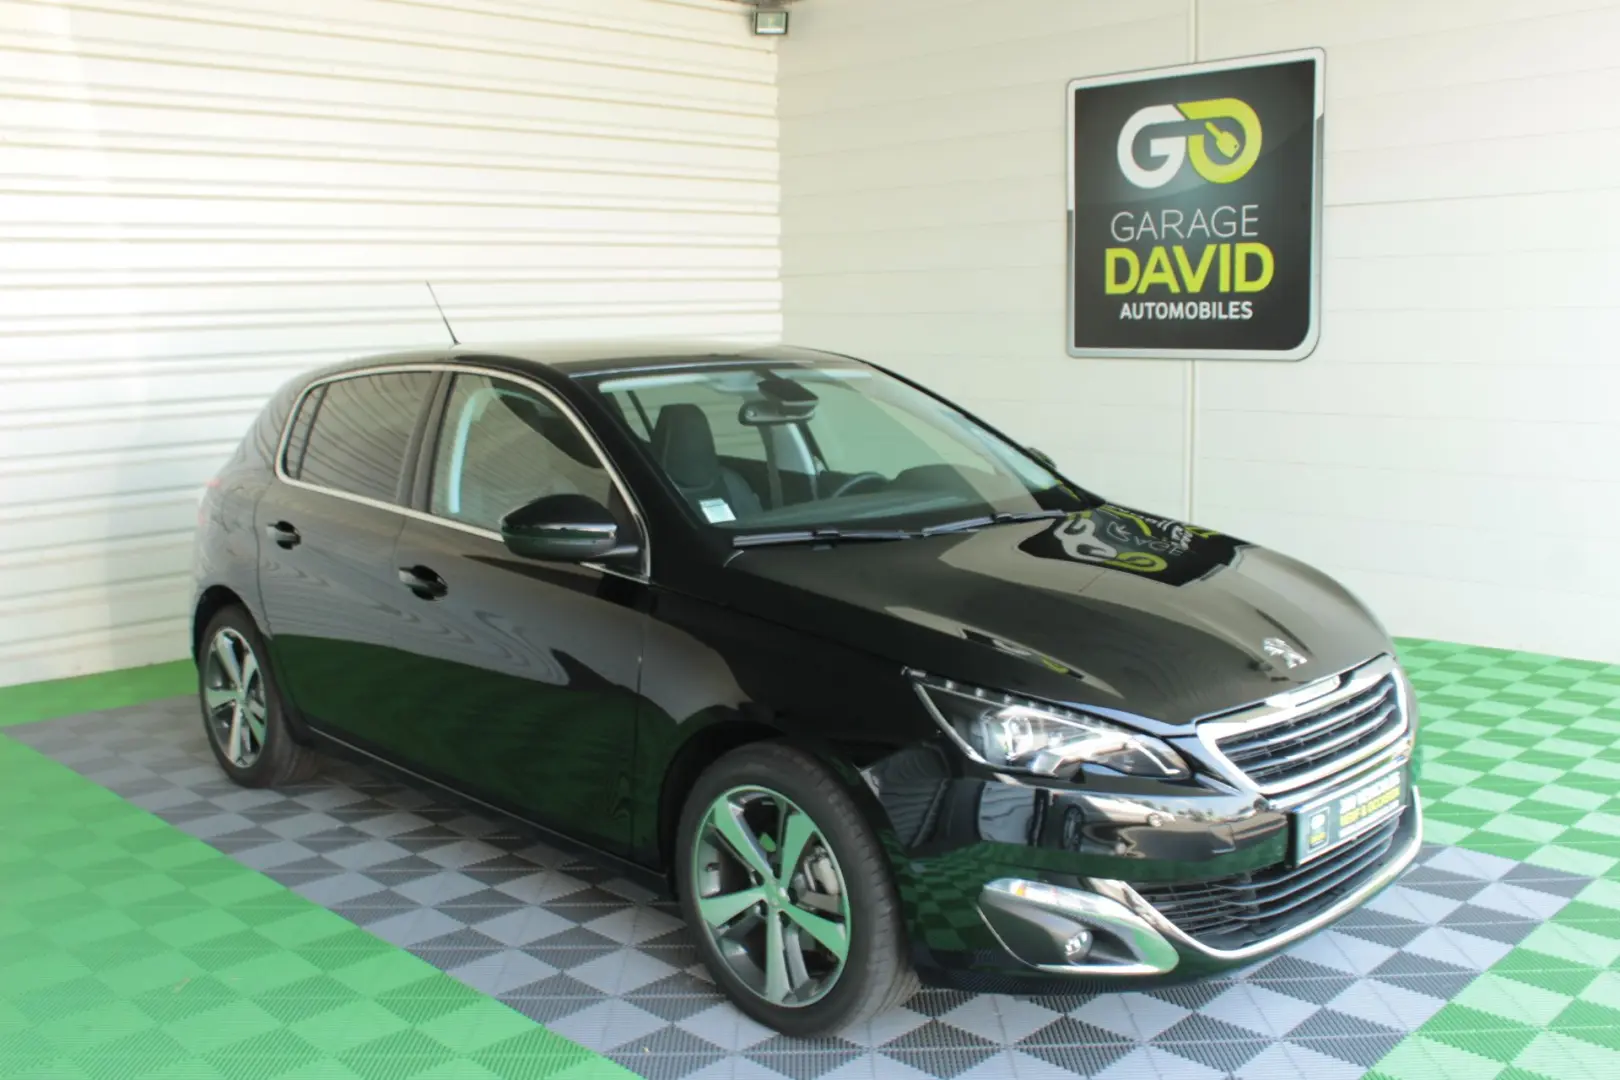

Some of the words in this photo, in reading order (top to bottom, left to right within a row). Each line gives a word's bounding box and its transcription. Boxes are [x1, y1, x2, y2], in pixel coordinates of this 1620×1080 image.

[1110, 204, 1259, 242] GARAGE
[1105, 242, 1275, 295] DAVID
[1119, 300, 1254, 320] AUTOMOBILES
